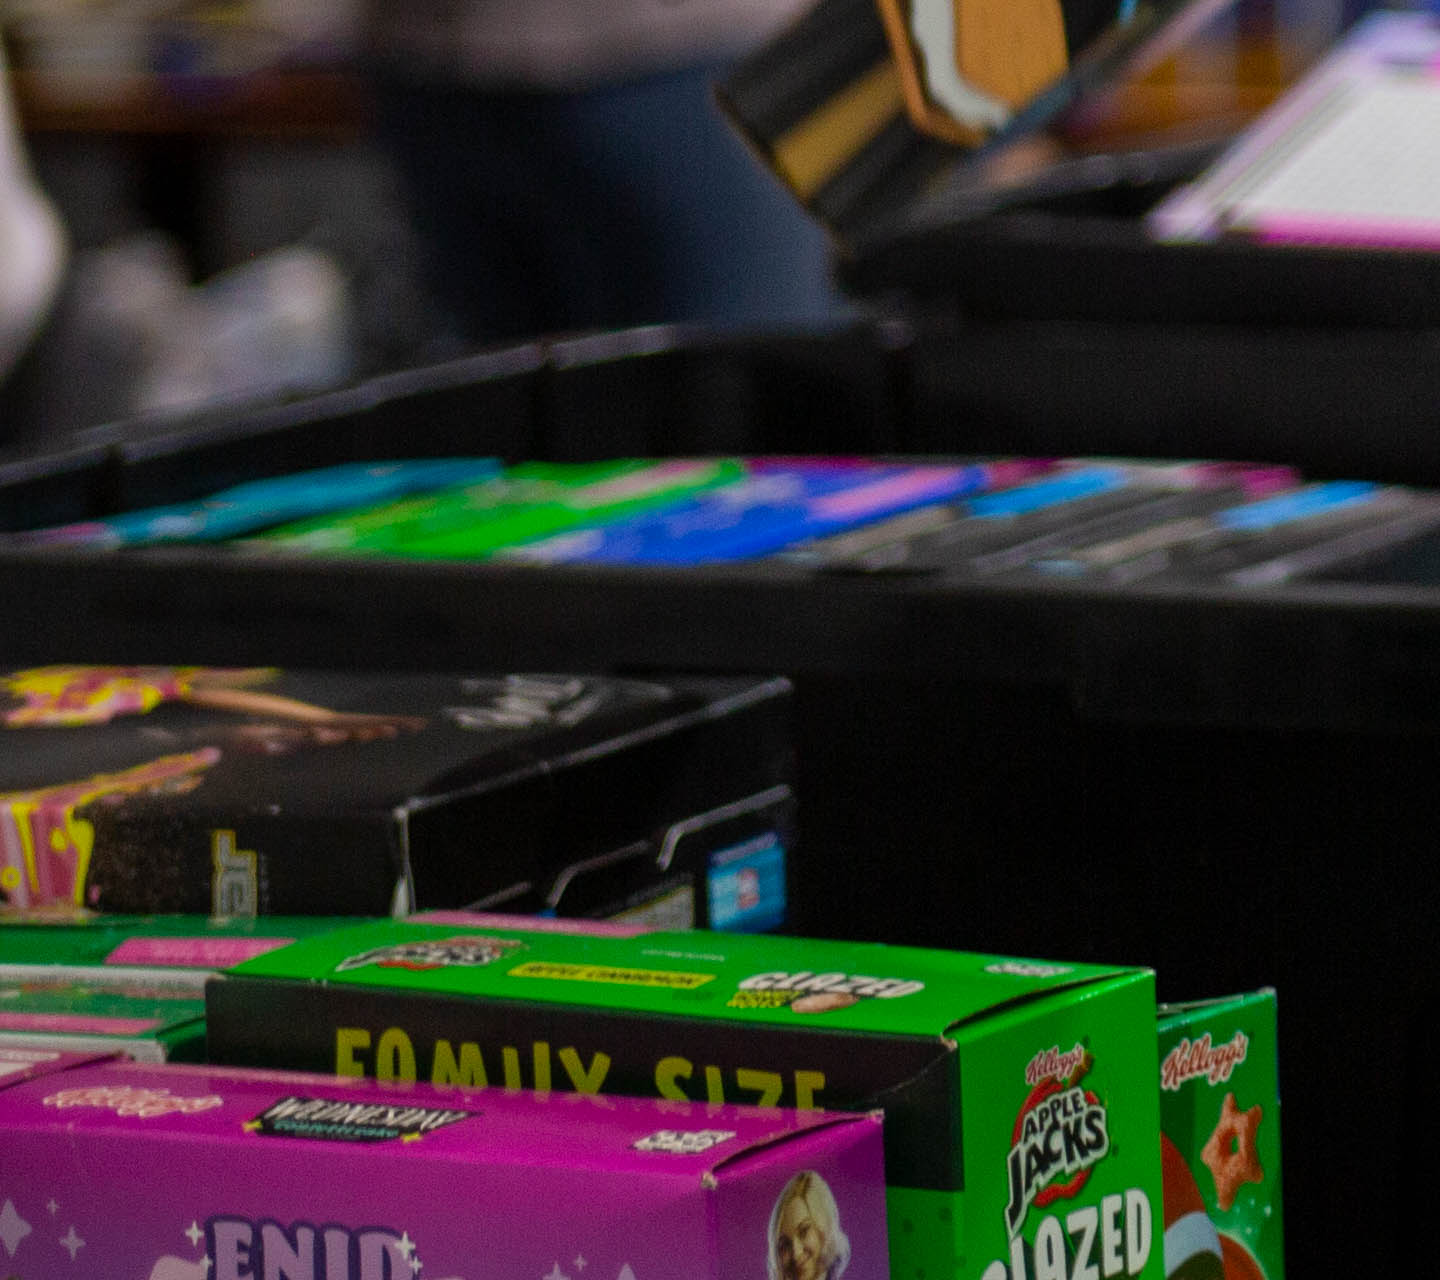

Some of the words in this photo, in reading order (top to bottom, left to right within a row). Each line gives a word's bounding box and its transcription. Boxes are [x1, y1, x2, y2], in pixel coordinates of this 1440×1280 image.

[1026, 1043, 1086, 1085] Kellogg's
[1160, 1032, 1249, 1090] Kellogg's
[1023, 1090, 1085, 1137] APPLE
[1008, 1109, 1107, 1232] JACKS
